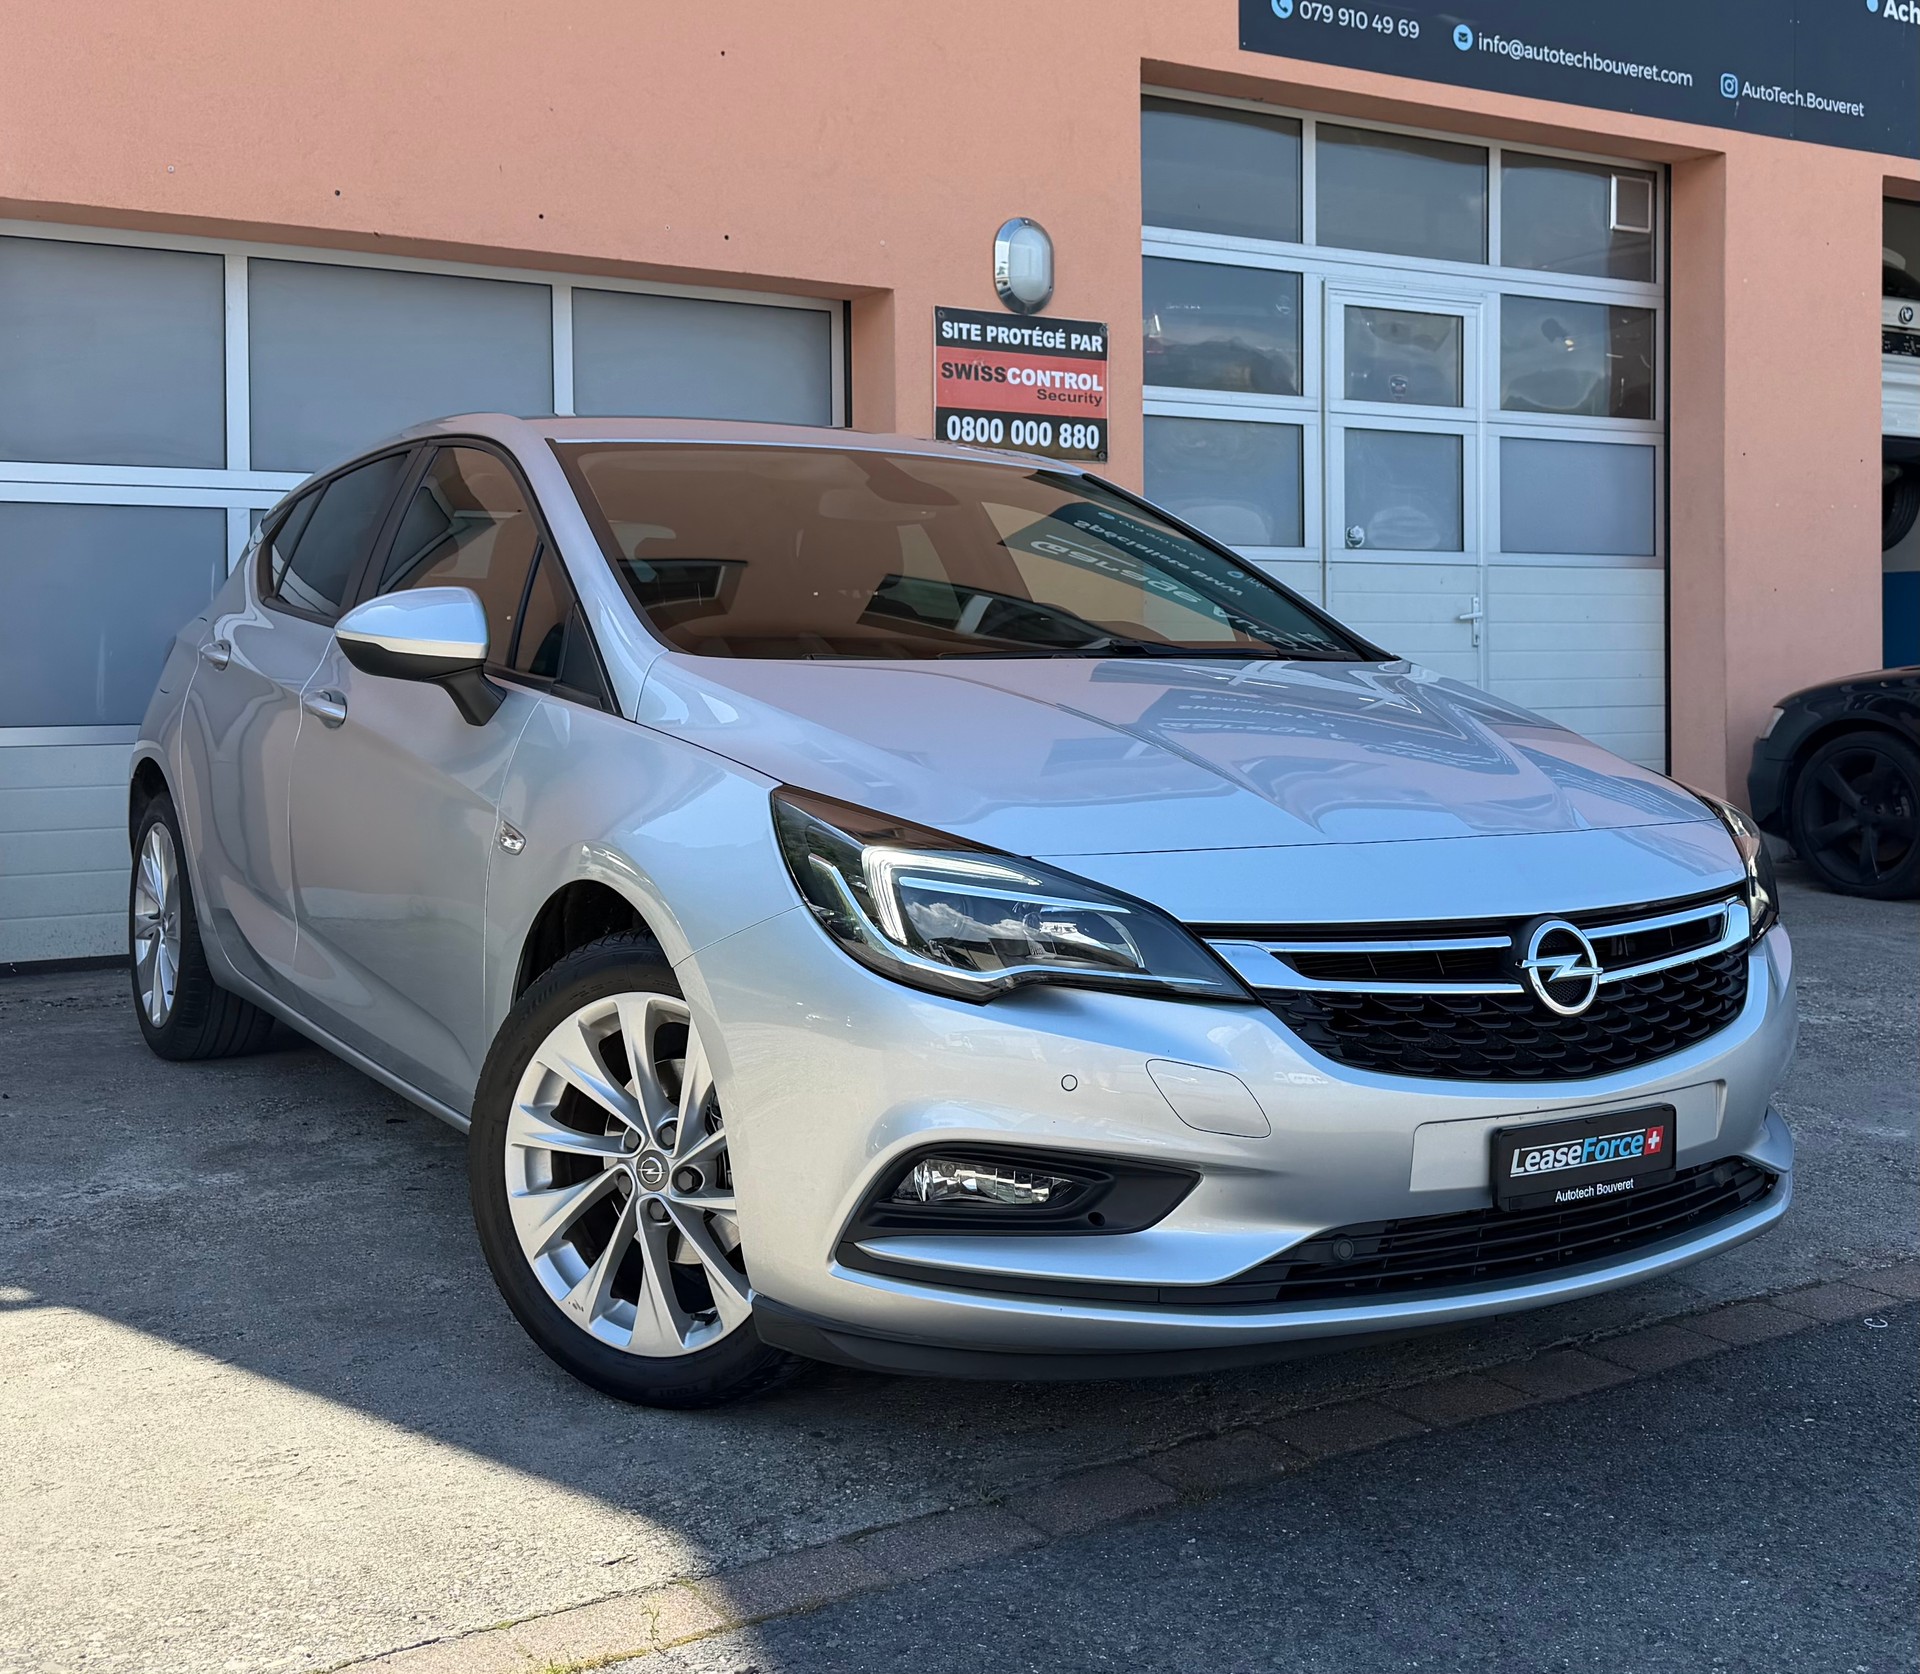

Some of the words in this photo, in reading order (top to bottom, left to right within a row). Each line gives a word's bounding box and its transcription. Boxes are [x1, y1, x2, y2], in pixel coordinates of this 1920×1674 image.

[1299, 1, 1334, 24] 079
[1338, 8, 1368, 30] 910
[1372, 14, 1394, 34] 49
[1398, 19, 1420, 39] 69
[1478, 32, 1692, 87] info@autotechbouveret.com
[1742, 81, 1865, 117] AutoTech.Bouveret
[941, 321, 982, 342] SITE
[986, 326, 1066, 349] PROTÉGÉ
[1071, 333, 1103, 352] PAR
[941, 362, 1103, 392] SWISSCONTROL
[1037, 388, 1103, 407] Security
[947, 415, 1004, 444] 0800
[1010, 420, 1052, 447] 000
[1058, 423, 1100, 450] 880
[1510, 1134, 1645, 1175] LeaseForce
[1555, 1185, 1595, 1203] Autotech
[1596, 1178, 1634, 1196] Bouveret
